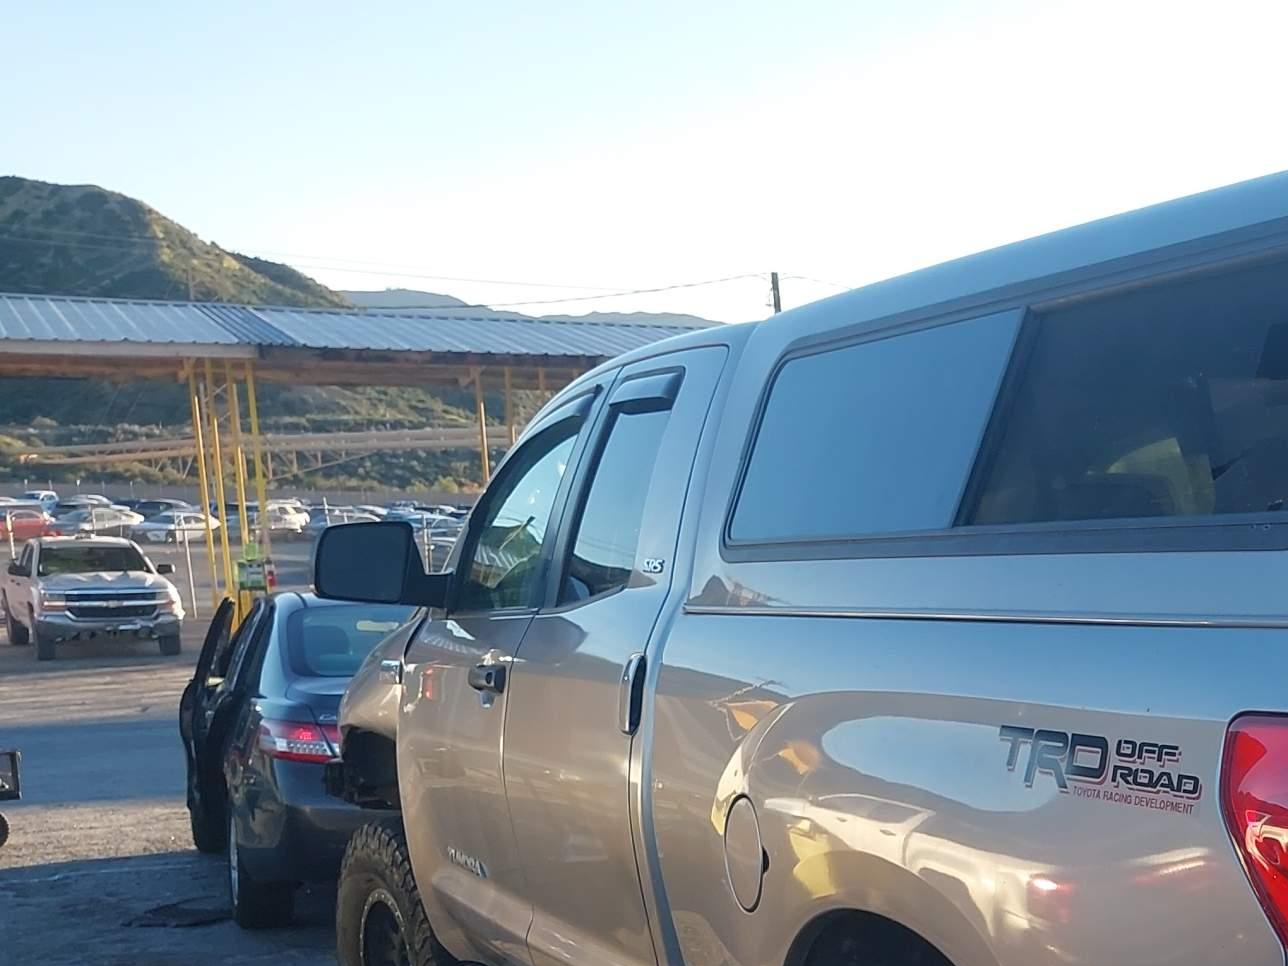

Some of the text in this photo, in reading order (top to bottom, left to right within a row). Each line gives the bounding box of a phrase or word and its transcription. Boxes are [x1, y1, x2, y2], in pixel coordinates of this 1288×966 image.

[999, 724, 1111, 793] TRD
[1115, 738, 1182, 767] OFF
[1110, 765, 1202, 800] ROAD
[1072, 785, 1195, 815] TOYOTA RACING DEVELOPMENT
